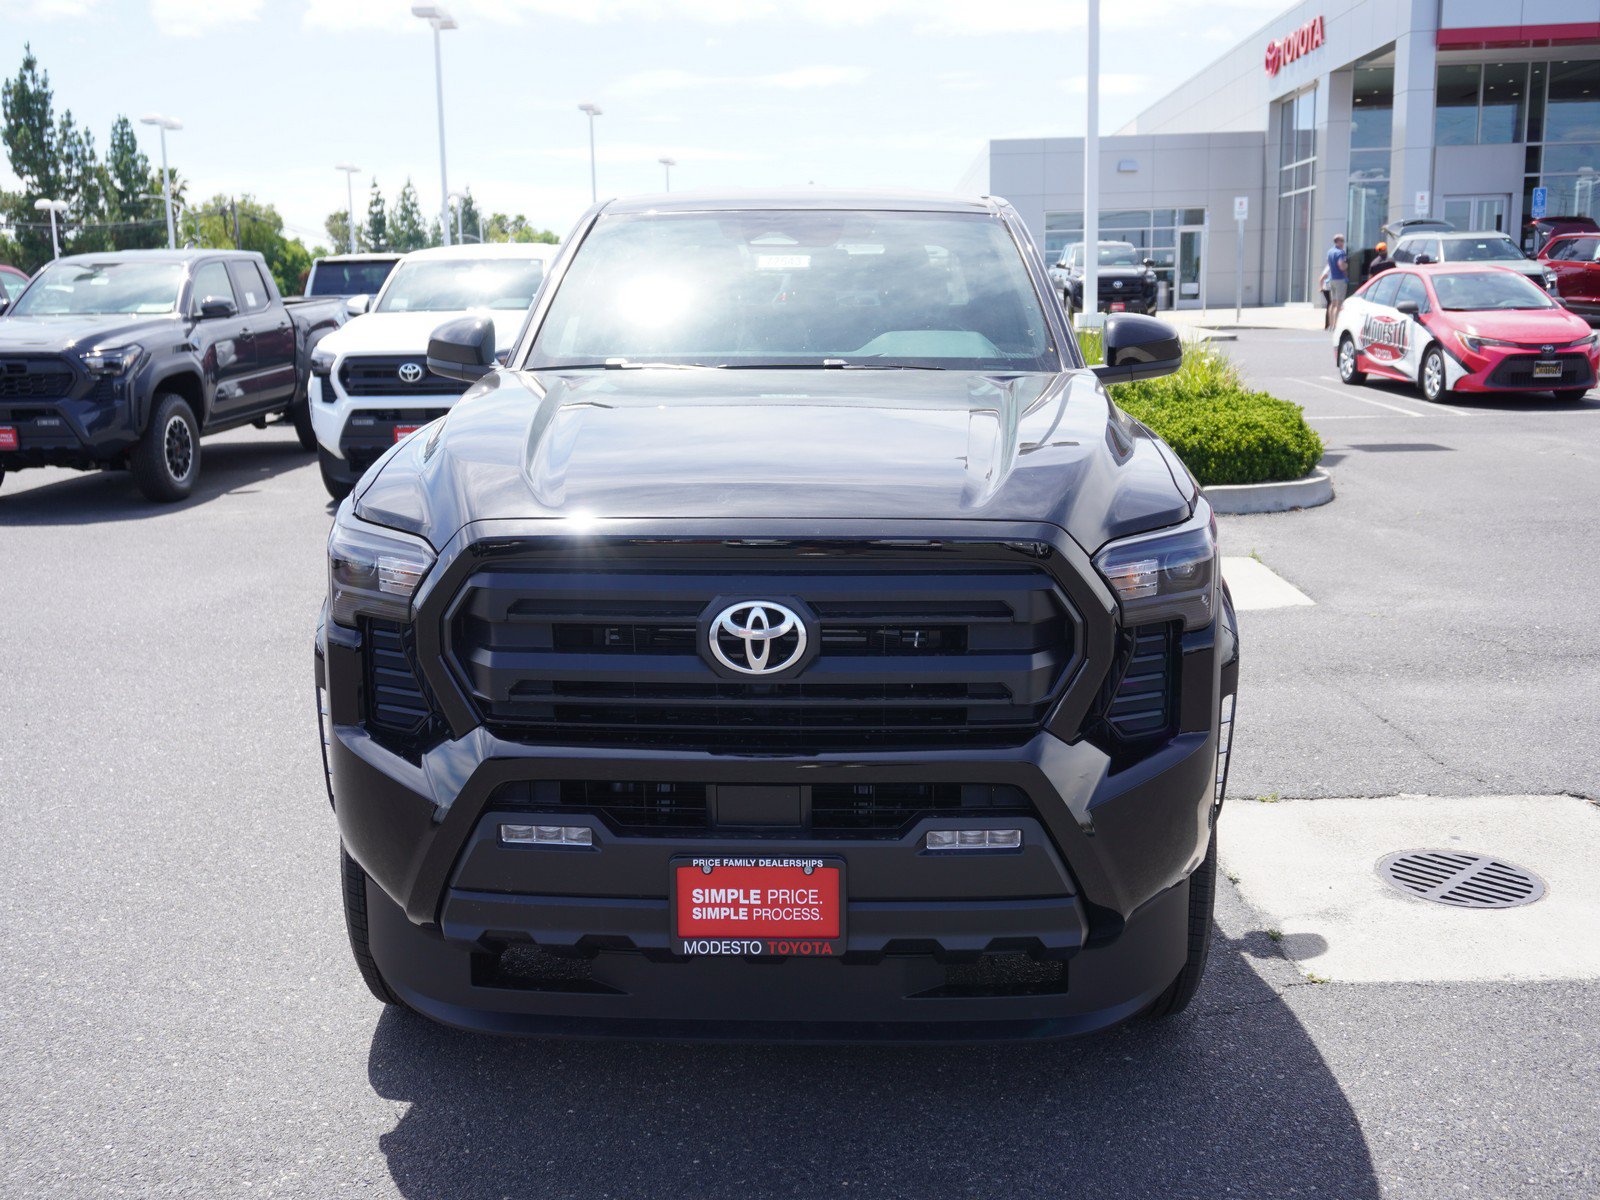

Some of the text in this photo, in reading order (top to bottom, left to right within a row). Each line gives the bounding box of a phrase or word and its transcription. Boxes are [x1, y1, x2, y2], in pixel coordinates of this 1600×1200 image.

[1281, 15, 1325, 67] TOYOTA
[1361, 314, 1407, 354] MODESTO
[692, 859, 824, 868] PRICE FAMILY DEALERSHIPS
[692, 888, 823, 904] SIMPLE PRICE.
[692, 907, 823, 921] SIMPLE PROCESS.
[683, 940, 833, 955] MODESTO TOYOTA
